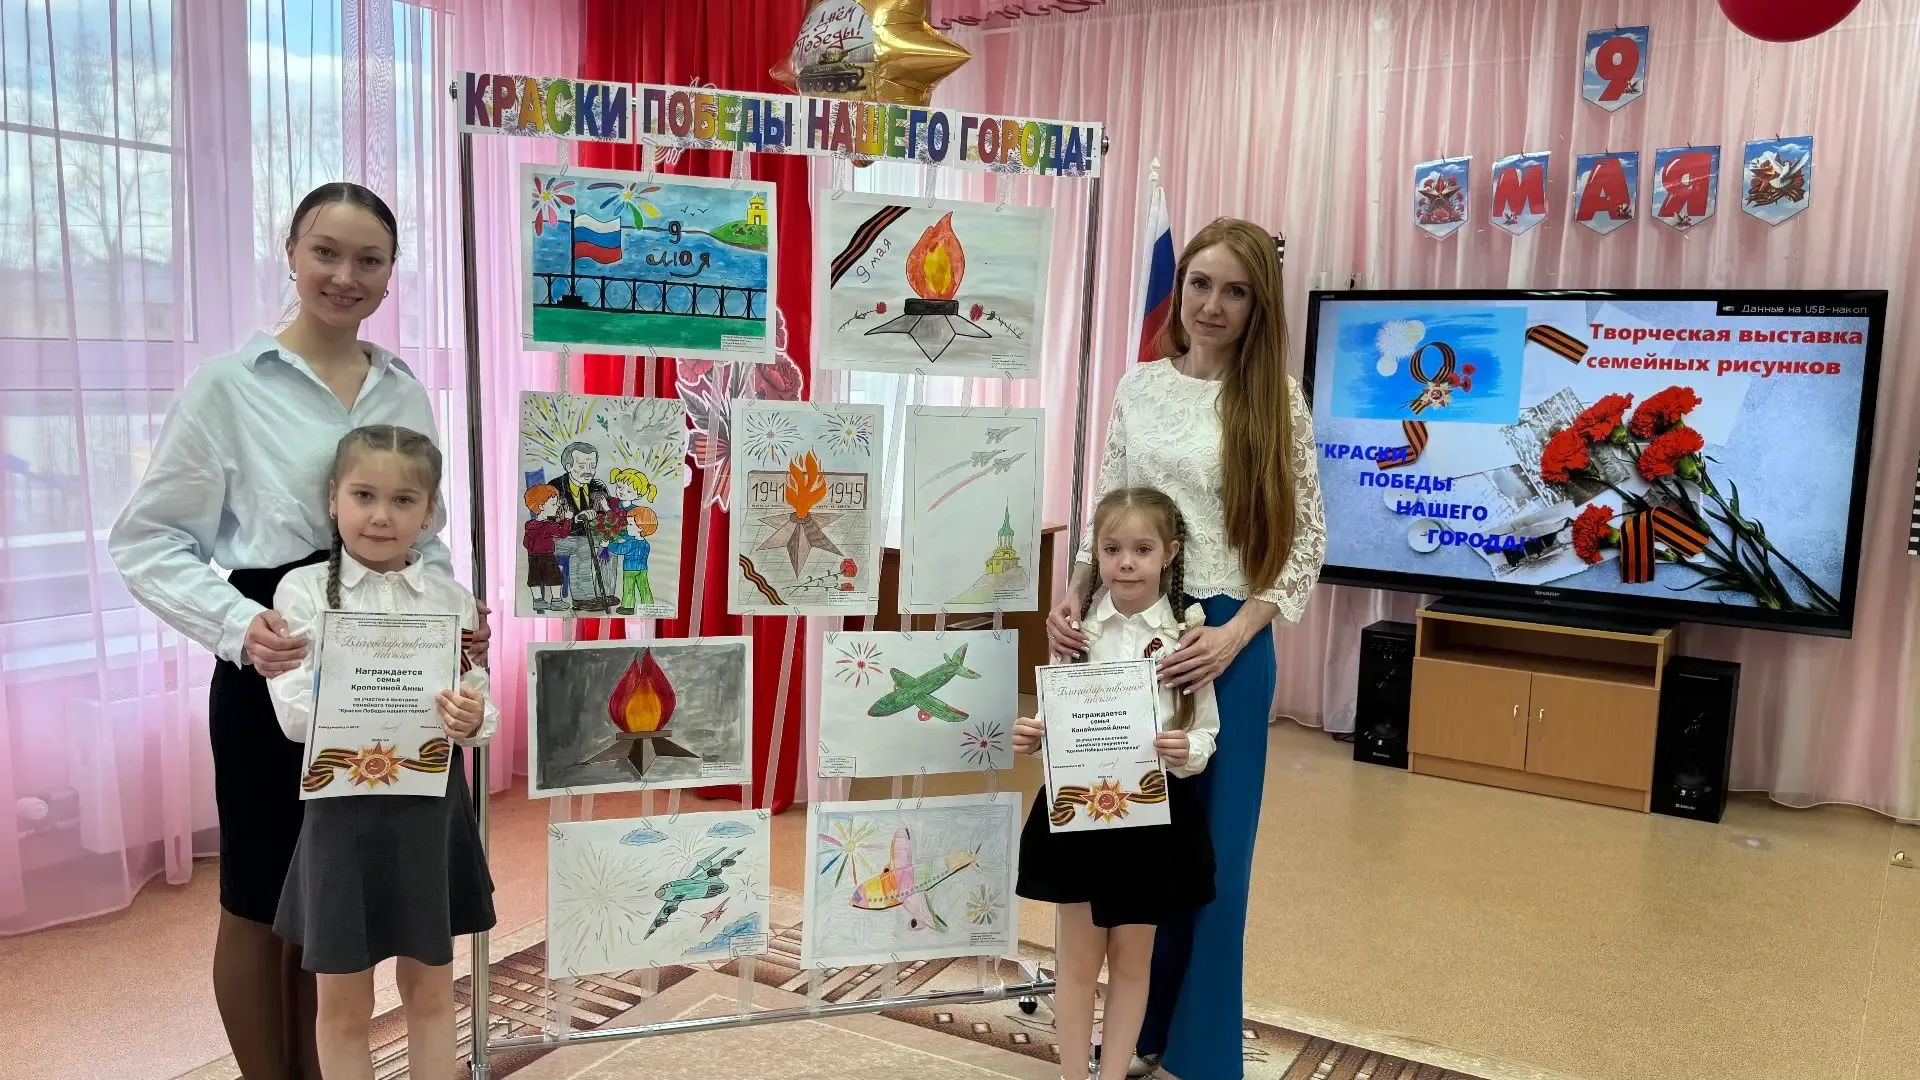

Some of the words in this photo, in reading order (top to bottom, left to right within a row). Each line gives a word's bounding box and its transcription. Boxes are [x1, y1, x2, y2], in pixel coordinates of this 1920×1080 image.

[1595, 36, 1640, 102] 9
[465, 72, 628, 139] КРАСКИ
[643, 88, 793, 151] ПОБЕДЫ
[807, 98, 950, 163] НАШЕГО
[959, 116, 1095, 176] ГОРОДА!
[668, 220, 682, 244] 9
[856, 265, 871, 284] 9
[871, 238, 892, 269] мая
[1741, 304, 1785, 313] Данные
[1788, 305, 1801, 313] на
[1805, 305, 1868, 314] USB-накоп
[1589, 323, 1731, 345] Творческая
[1738, 328, 1863, 344] выставка
[1586, 353, 1710, 372] семейных
[1717, 358, 1841, 378] рисунков
[751, 481, 786, 503] 1941
[828, 481, 864, 505] 1945
[1359, 472, 1454, 494] ПОБЕДЫ
[1396, 500, 1489, 521] НАШЕГО
[355, 667, 423, 677] Награждается
[351, 684, 401, 692] Кропотиной
[1072, 710, 1127, 720] Награждается
